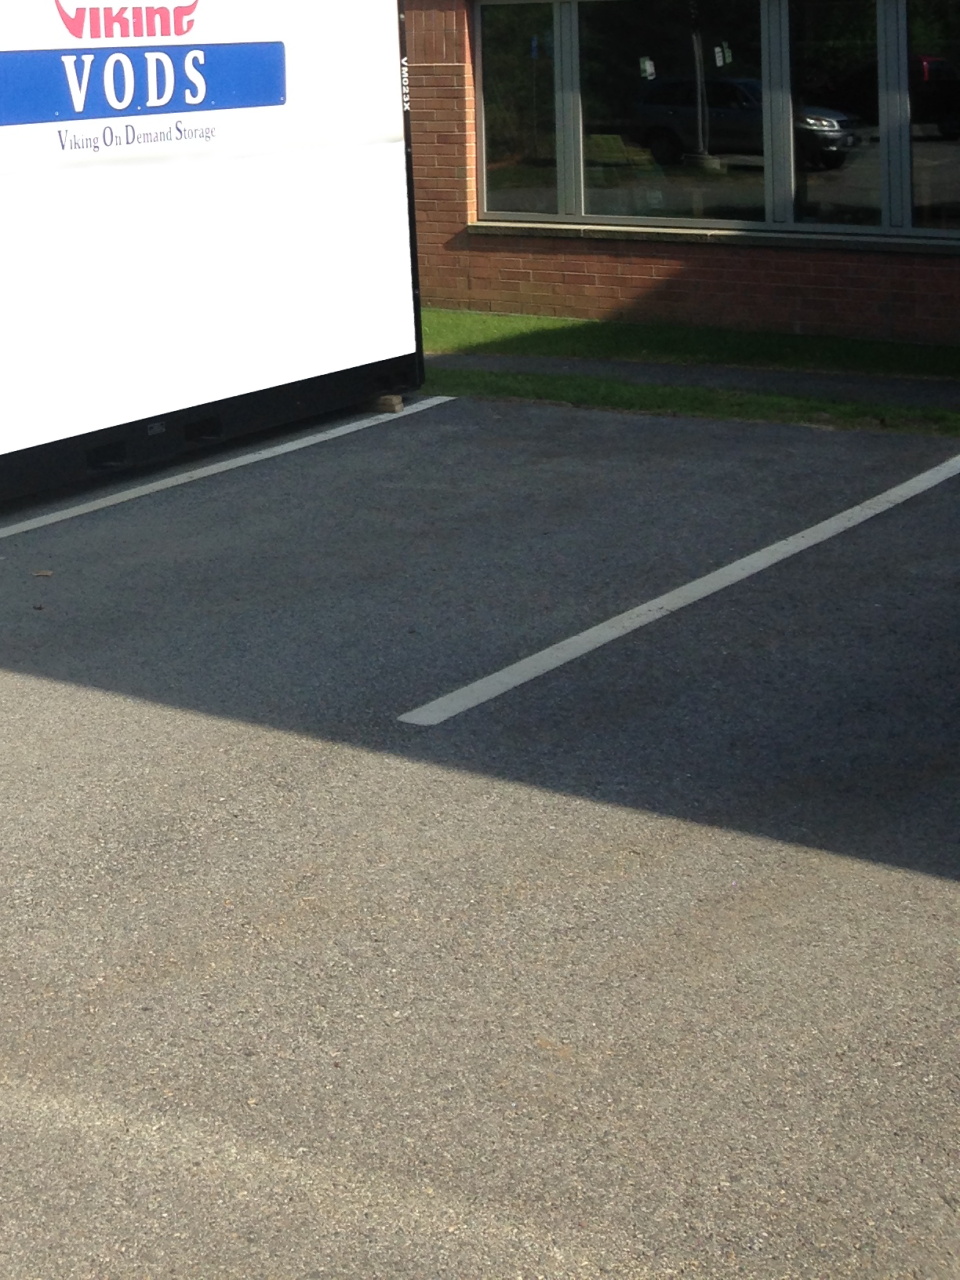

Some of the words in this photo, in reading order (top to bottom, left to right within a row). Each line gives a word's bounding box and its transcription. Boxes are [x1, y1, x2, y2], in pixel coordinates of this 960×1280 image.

[60, 50, 207, 113] VODS
[401, 56, 410, 112] VM023X
[57, 129, 100, 153] Viking
[102, 126, 122, 147] On
[125, 124, 173, 145] Demand
[175, 120, 217, 142] Storage
